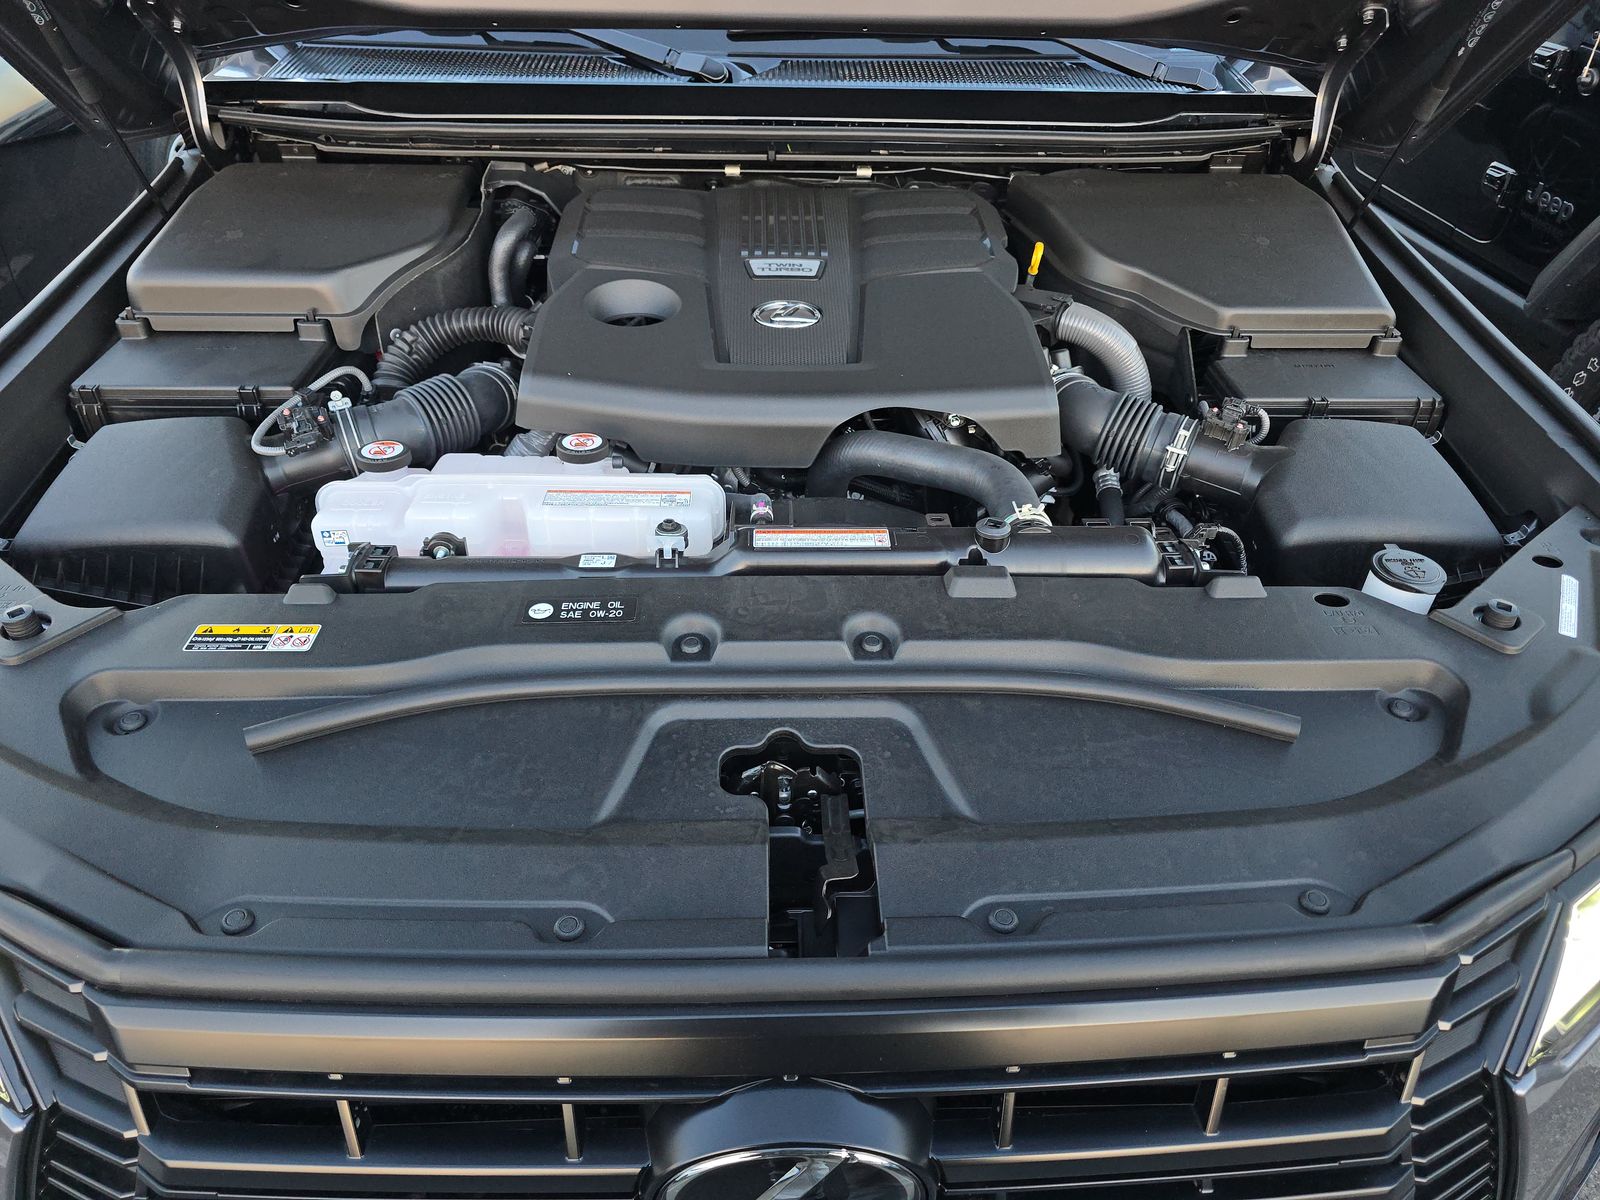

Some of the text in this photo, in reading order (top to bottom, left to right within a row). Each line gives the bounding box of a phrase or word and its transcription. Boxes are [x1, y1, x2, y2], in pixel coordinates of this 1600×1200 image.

[1525, 181, 1575, 222] Jeep
[561, 601, 625, 610] ENGINE OIL
[560, 610, 623, 619] SAE 0W-20
